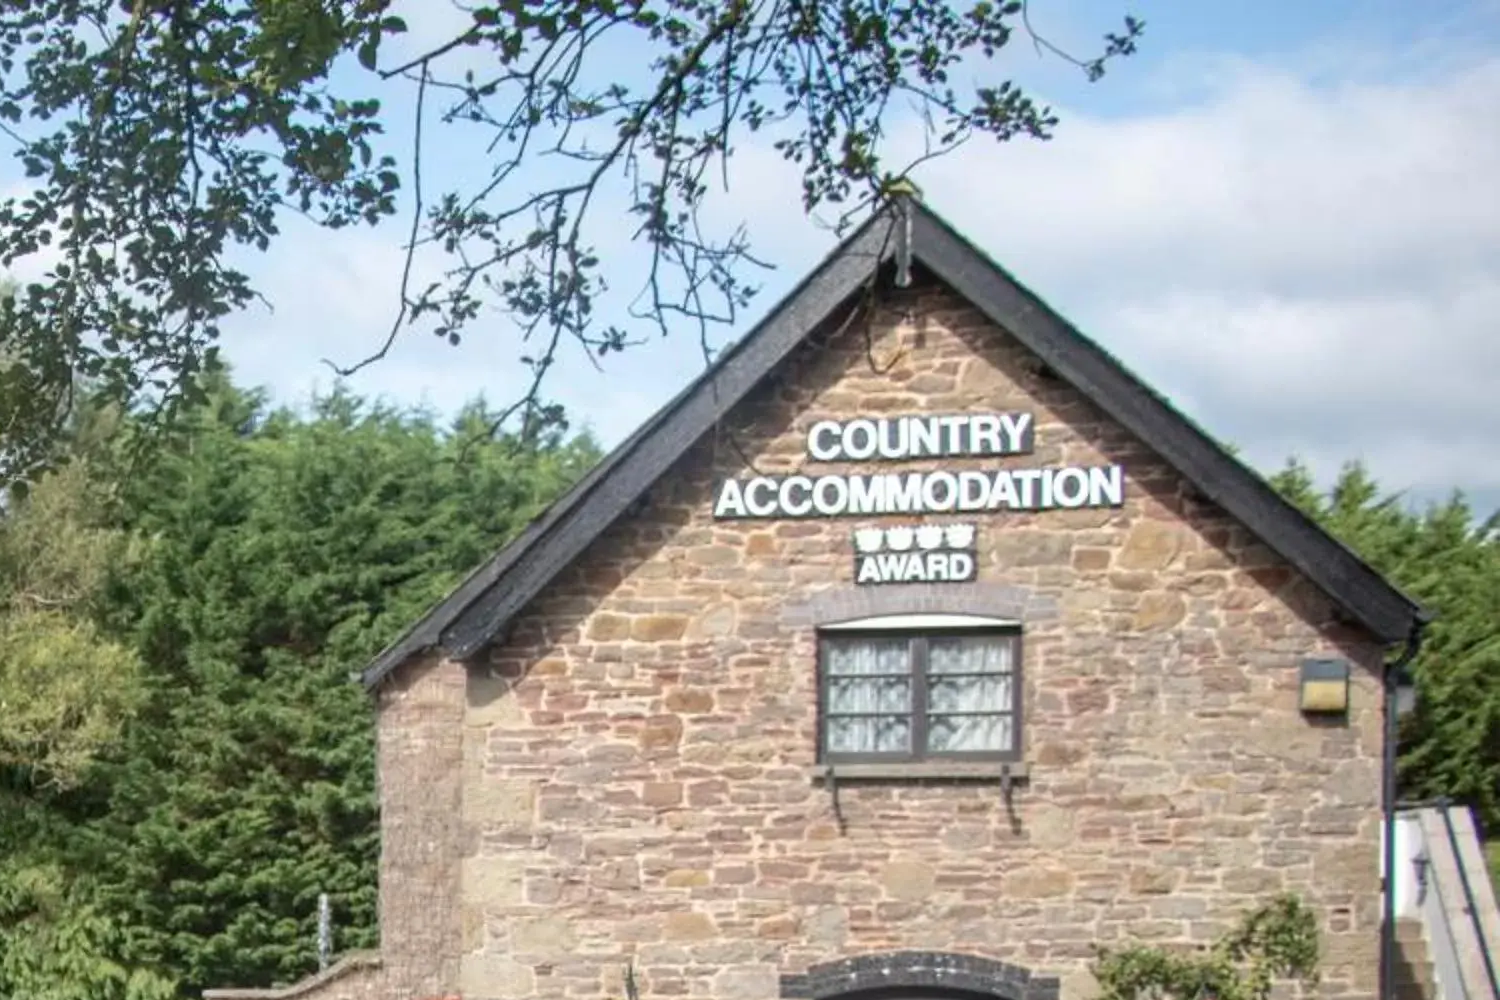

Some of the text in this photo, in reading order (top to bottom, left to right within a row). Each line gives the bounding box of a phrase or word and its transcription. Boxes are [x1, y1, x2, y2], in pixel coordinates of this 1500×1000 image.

[807, 413, 1031, 460] COUNTRY
[715, 466, 1121, 516] ACCOMMODATION
[858, 554, 972, 582] AWARD
